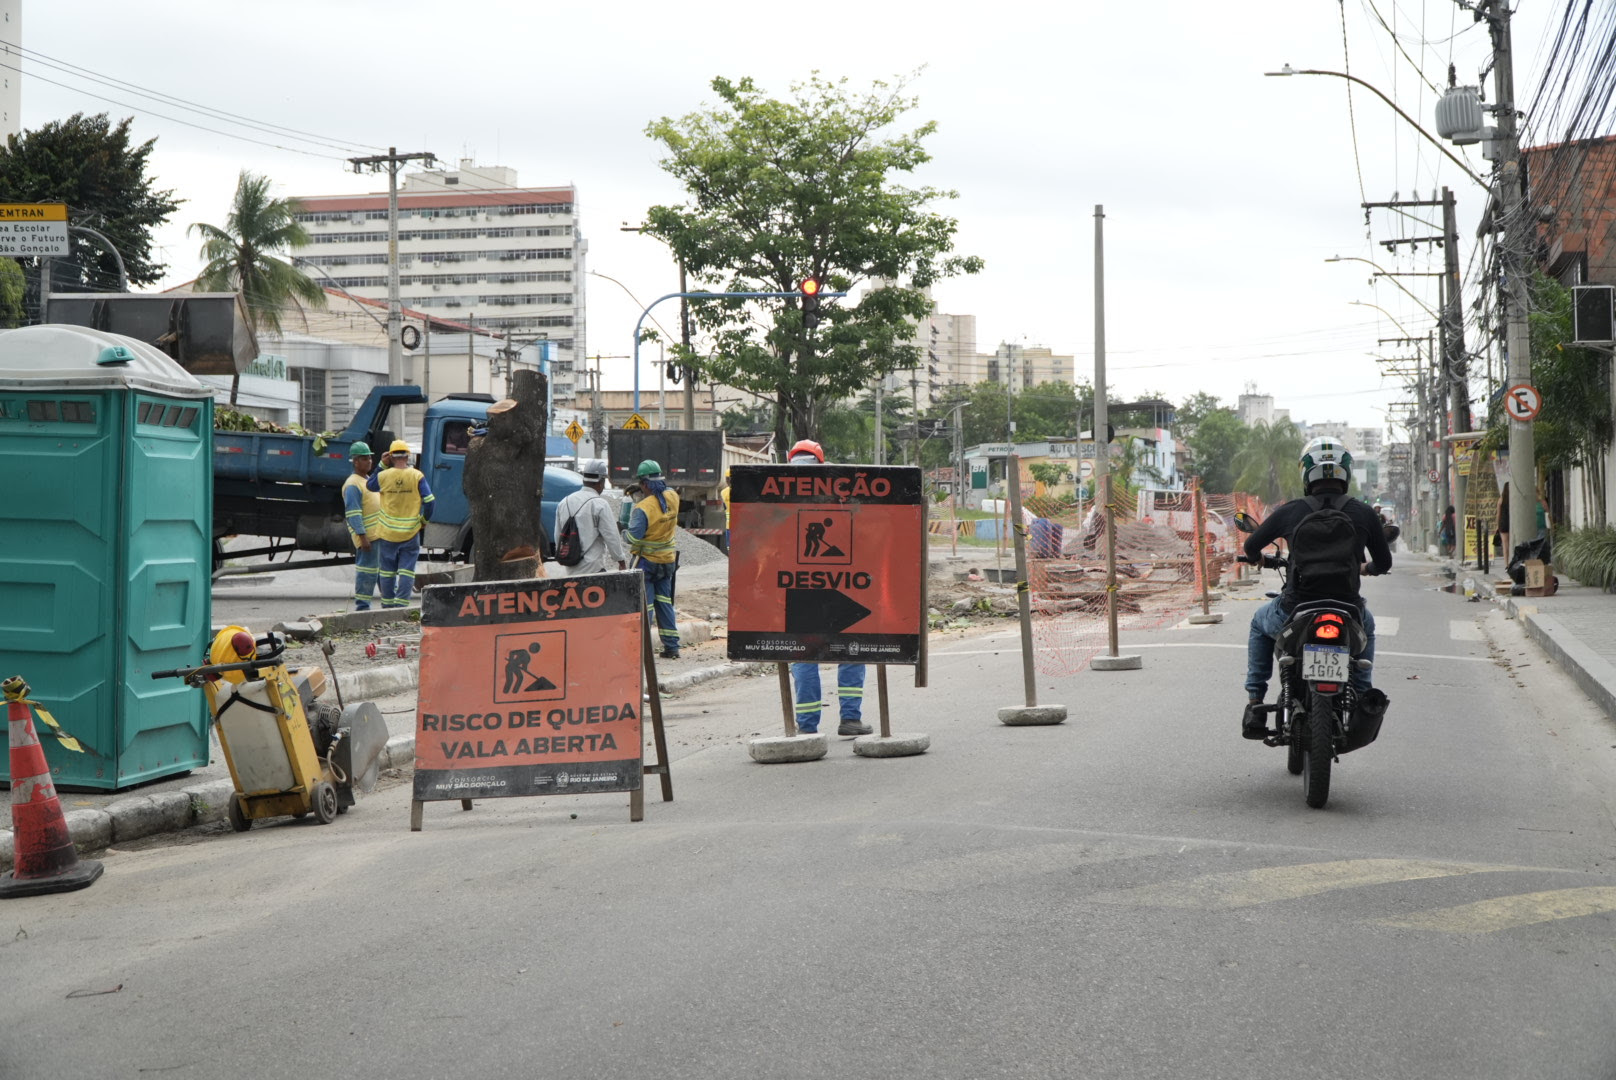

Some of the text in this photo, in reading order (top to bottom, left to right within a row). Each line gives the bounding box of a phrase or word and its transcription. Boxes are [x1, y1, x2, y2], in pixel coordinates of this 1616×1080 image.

[20, 245, 60, 253] Gonçalo
[1050, 444, 1072, 453] AUTO
[972, 464, 986, 472] BR
[761, 472, 891, 502] ATENÇÃO
[777, 570, 872, 590] DESVIO
[458, 582, 606, 618] ATENÇÃO
[1314, 652, 1339, 665] LTS
[422, 702, 636, 732] RISCO DE QUEDA
[440, 733, 618, 760] VALA ABERTA
[454, 781, 469, 789] SÃO
[470, 780, 506, 788] GONÇALO
